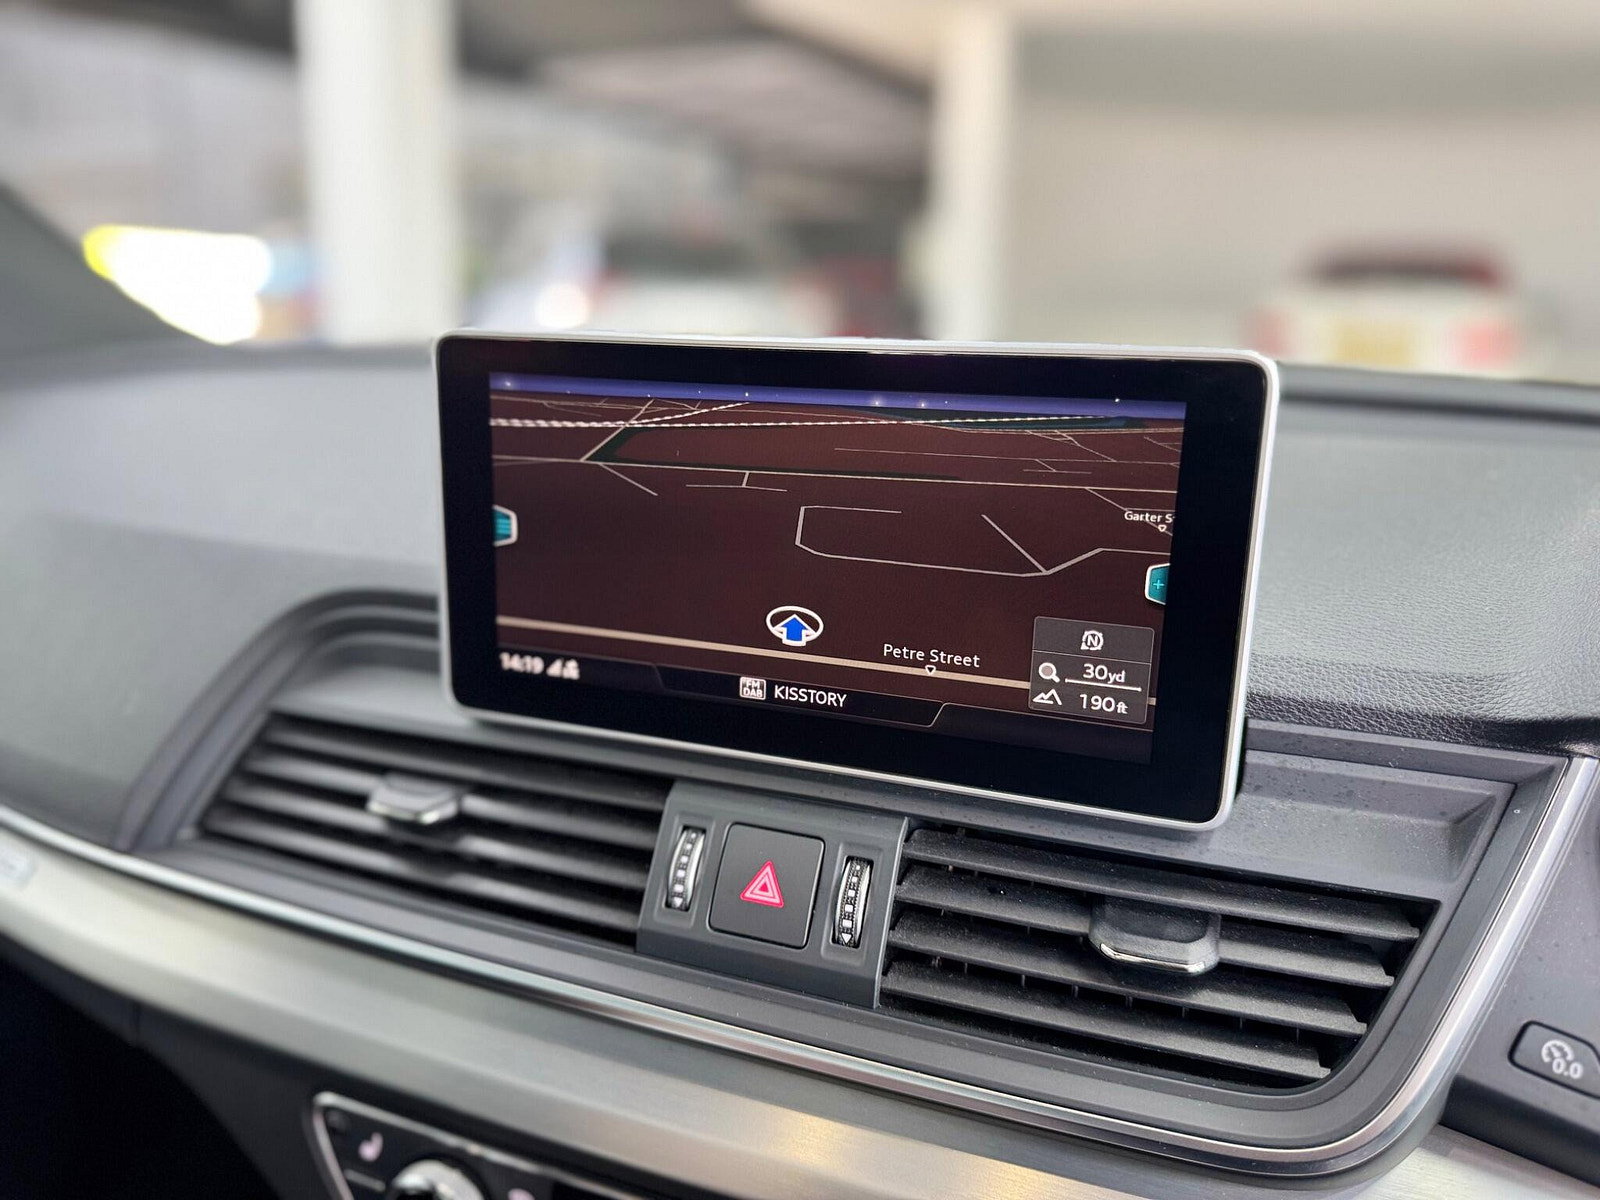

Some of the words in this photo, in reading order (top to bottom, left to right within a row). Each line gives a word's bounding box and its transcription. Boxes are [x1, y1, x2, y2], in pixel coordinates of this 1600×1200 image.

[1124, 511, 1162, 522] Garter
[883, 643, 925, 661] Petre
[929, 649, 980, 668] Street
[746, 680, 760, 689] FM
[743, 688, 763, 698] DAB
[774, 684, 847, 708] KISSTORY
[1552, 1057, 1583, 1079] 0.0
